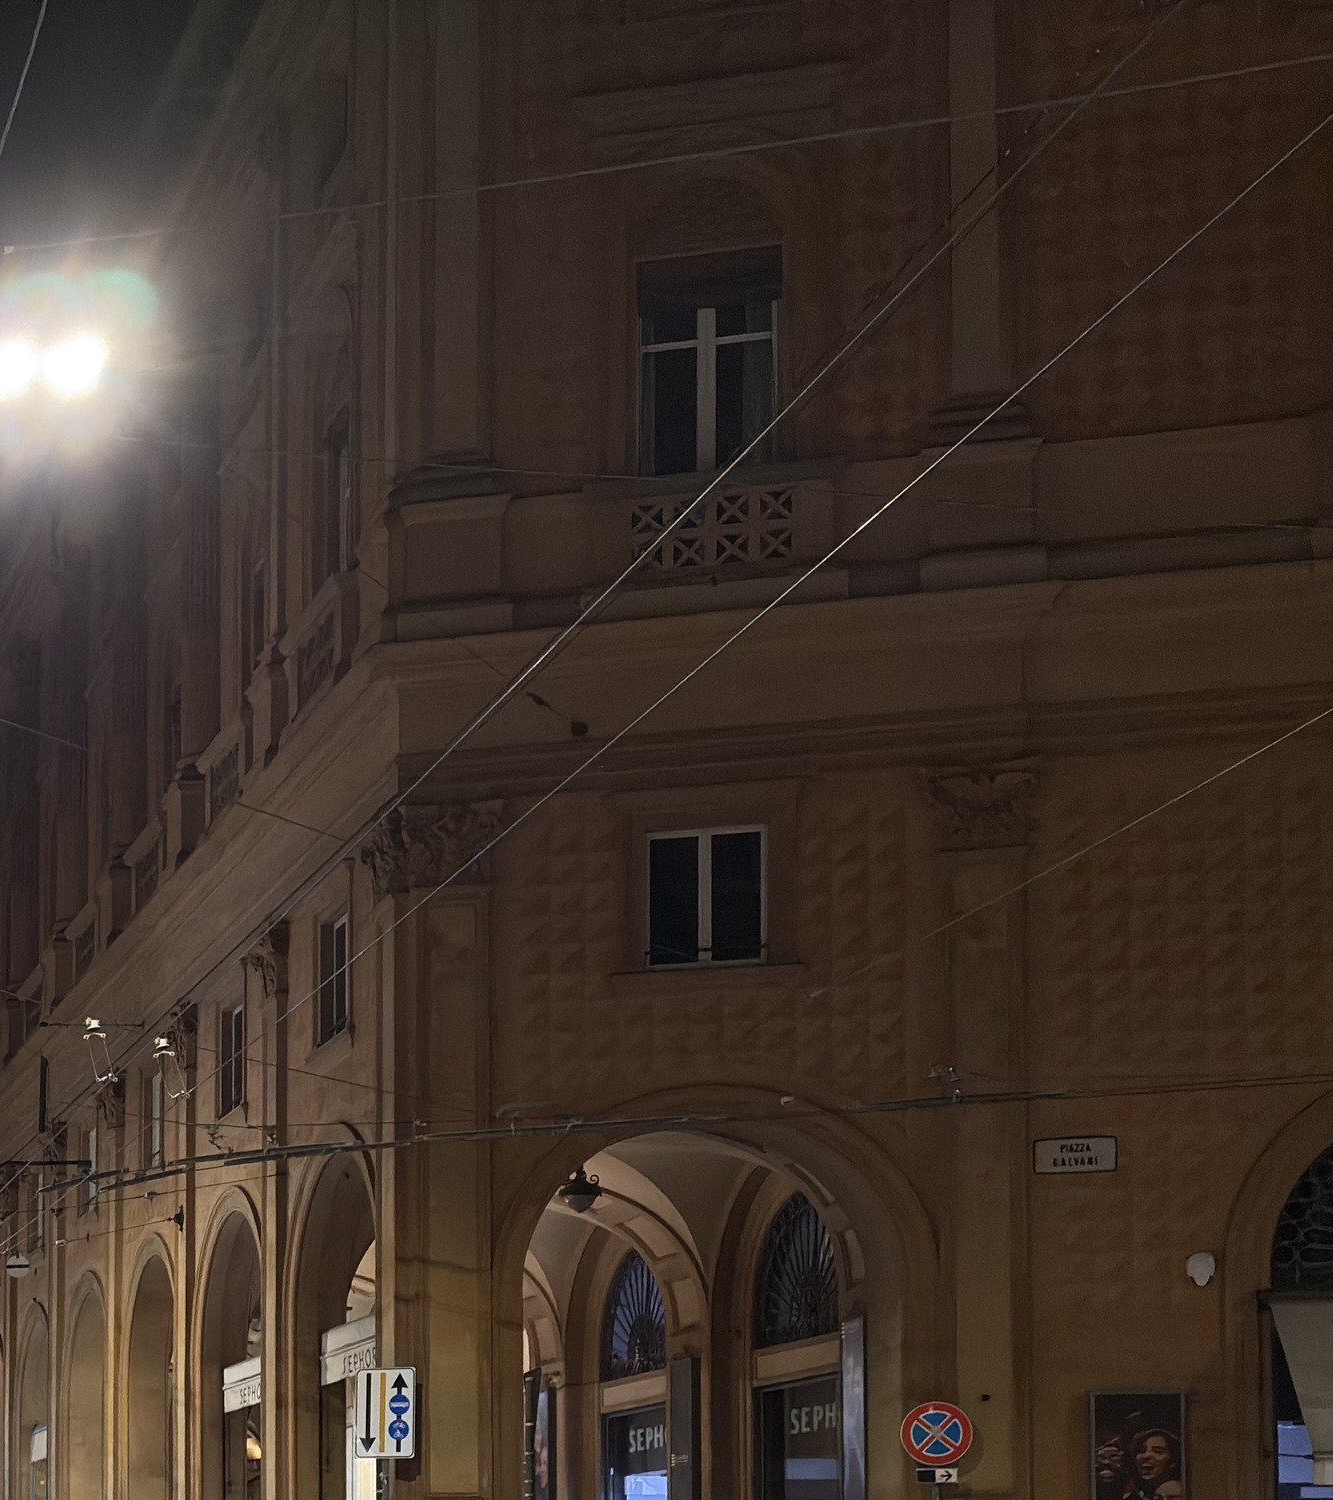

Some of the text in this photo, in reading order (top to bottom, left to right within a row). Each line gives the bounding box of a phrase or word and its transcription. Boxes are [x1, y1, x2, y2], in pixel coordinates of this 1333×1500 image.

[1060, 1143, 1092, 1153] PIAZZA
[1053, 1157, 1098, 1167] GALVANI
[629, 1424, 667, 1453] SEPH
